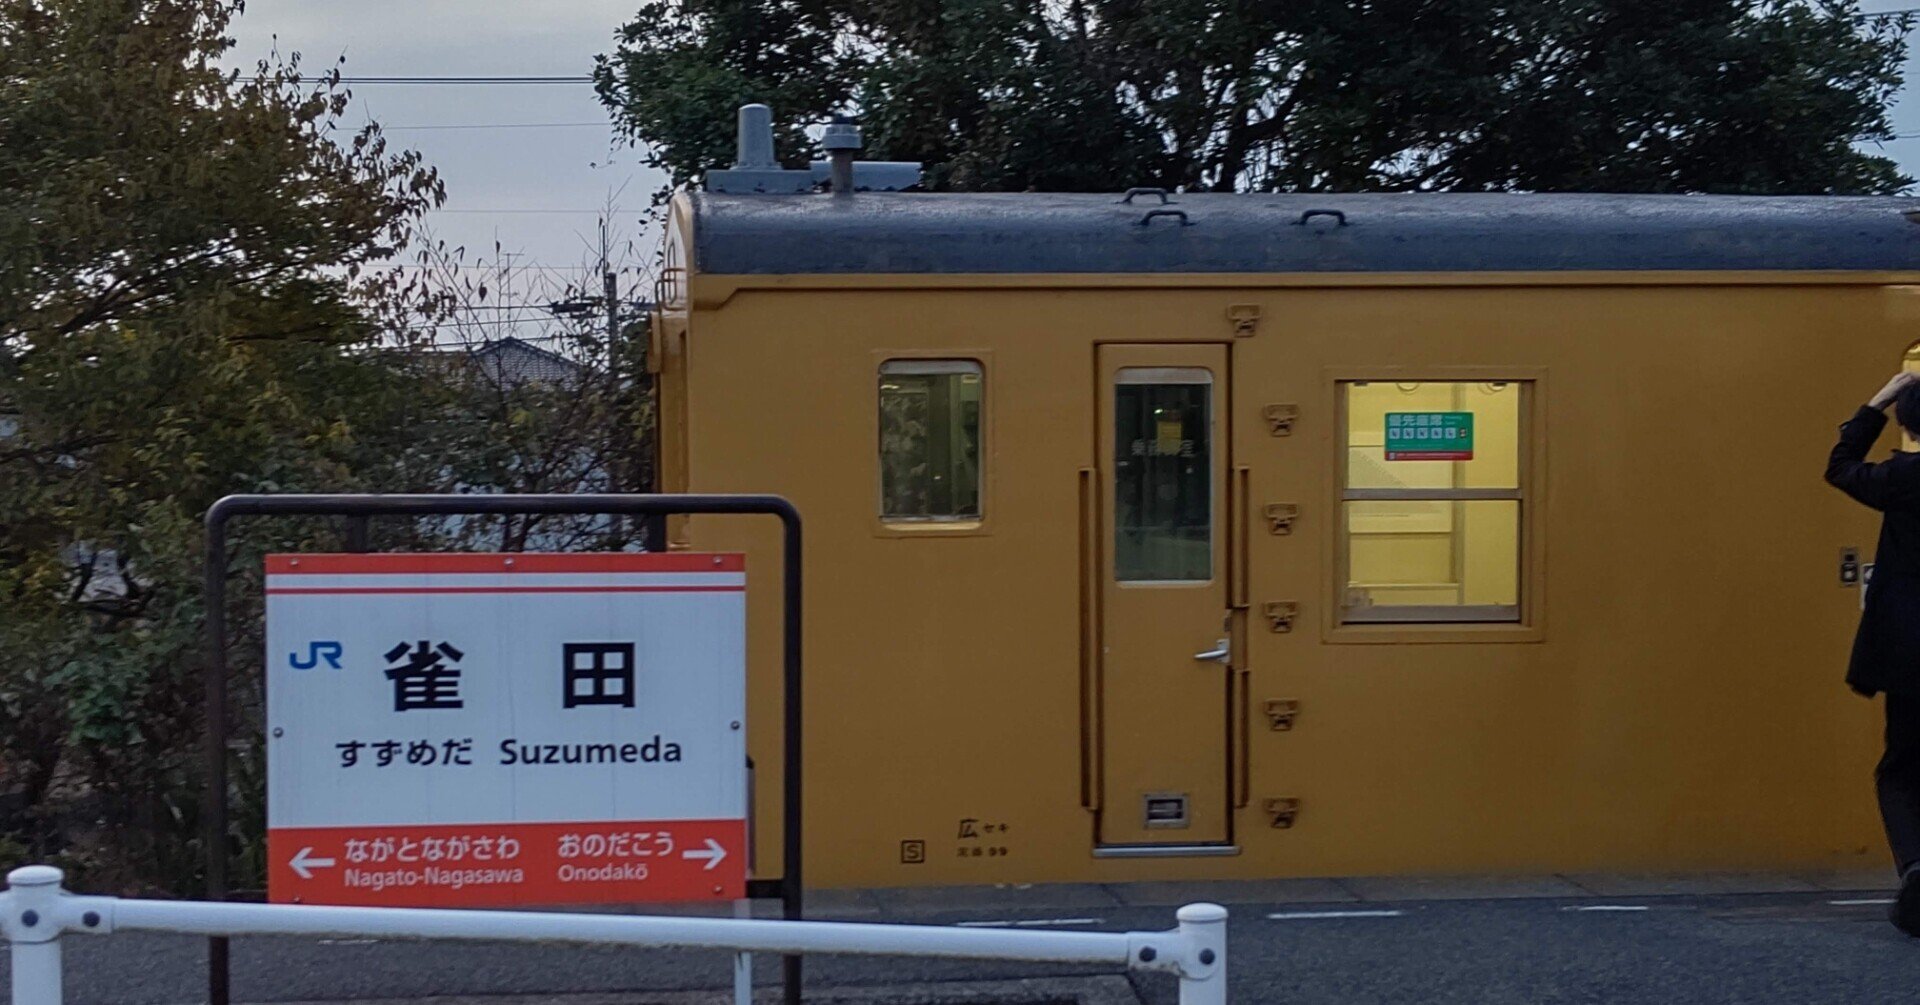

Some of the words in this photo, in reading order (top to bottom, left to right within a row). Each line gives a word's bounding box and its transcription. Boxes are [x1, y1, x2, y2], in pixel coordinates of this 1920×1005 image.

[289, 641, 343, 670] JR
[383, 640, 636, 712] 雀田
[335, 738, 473, 767] すずめだ
[500, 735, 682, 765] Suzumeda
[344, 835, 520, 862] ながとながさわ
[557, 831, 674, 858] おのだこう
[344, 866, 524, 891] Nagato-Nagasawa
